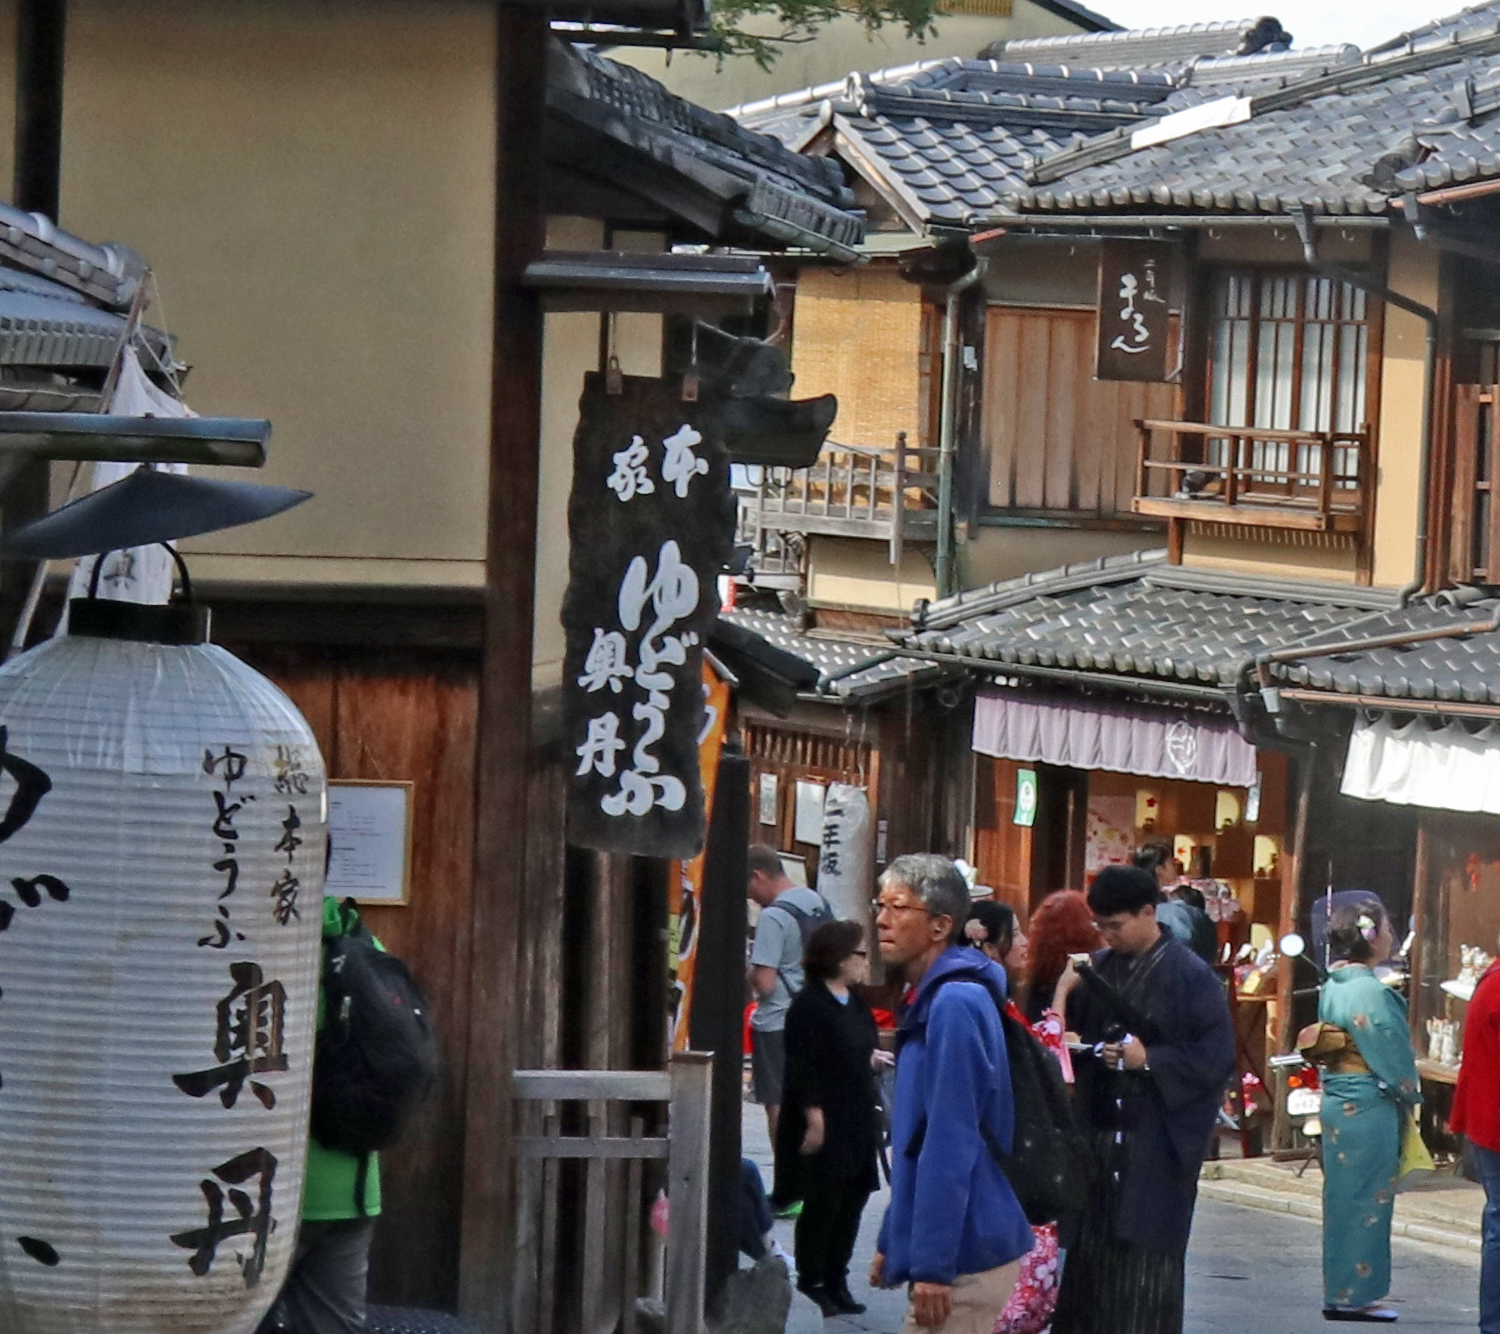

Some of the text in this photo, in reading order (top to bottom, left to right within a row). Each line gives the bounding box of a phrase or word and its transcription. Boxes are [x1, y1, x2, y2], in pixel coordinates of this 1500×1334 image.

[576, 628, 634, 778] 奥丹
[600, 539, 700, 817] ゆどうふ
[197, 744, 257, 949] ゆどうふ
[171, 961, 290, 1290] 奥丹
